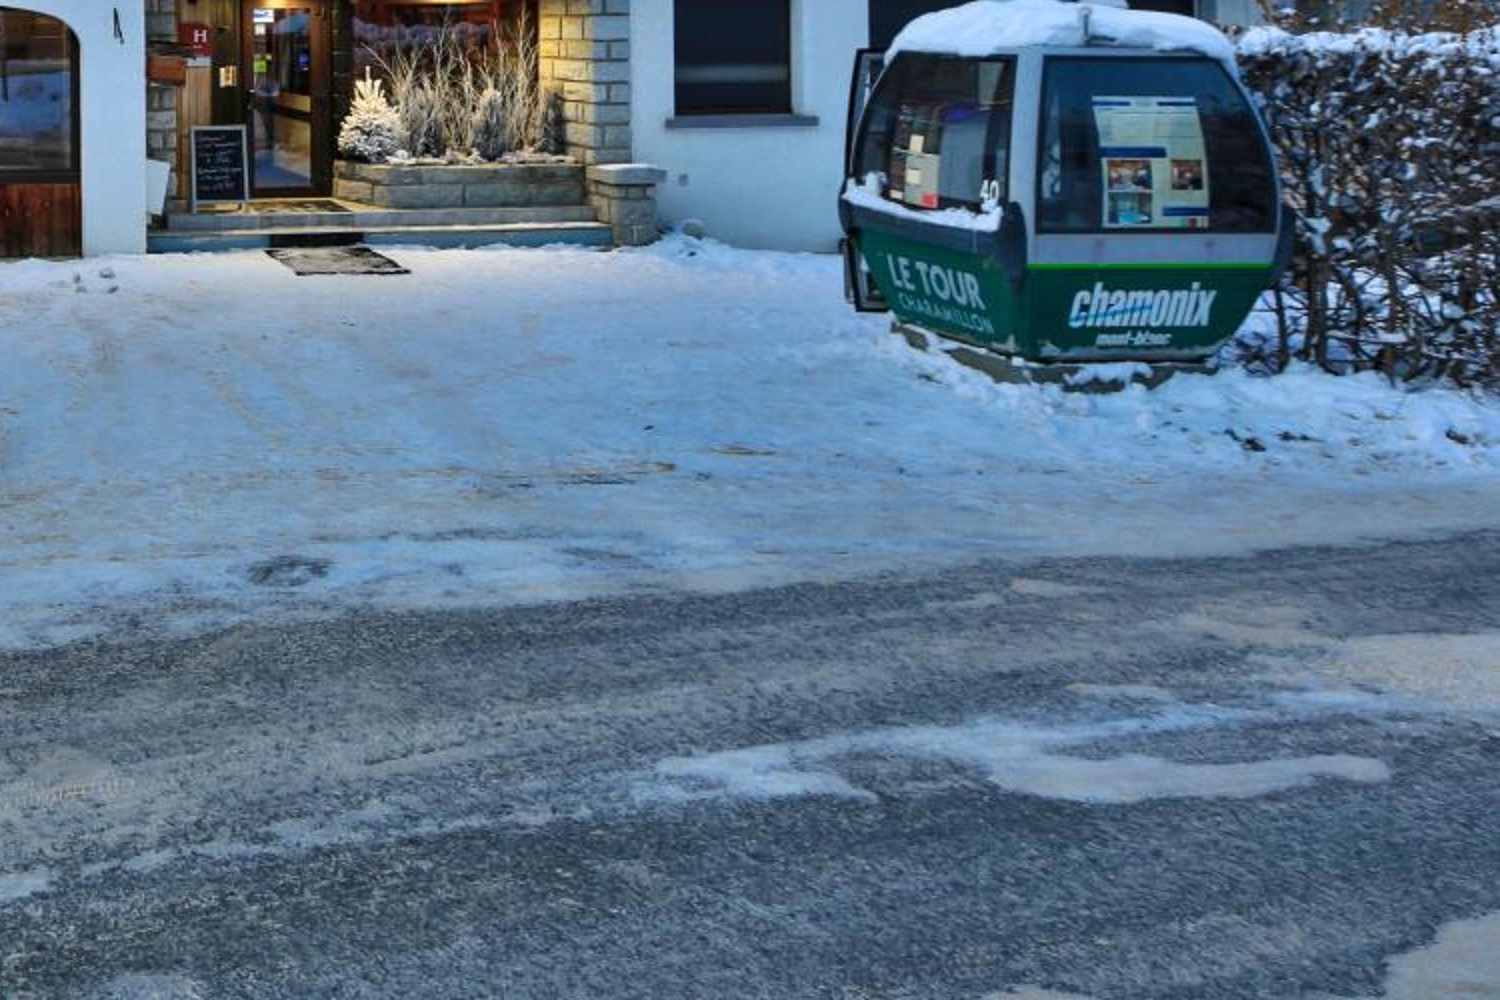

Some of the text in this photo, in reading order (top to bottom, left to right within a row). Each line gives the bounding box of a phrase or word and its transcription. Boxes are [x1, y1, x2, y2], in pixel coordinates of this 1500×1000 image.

[194, 29, 207, 43] H
[979, 179, 1000, 202] 40
[887, 253, 986, 310] LE TOUR
[1068, 281, 1217, 328] chamonix
